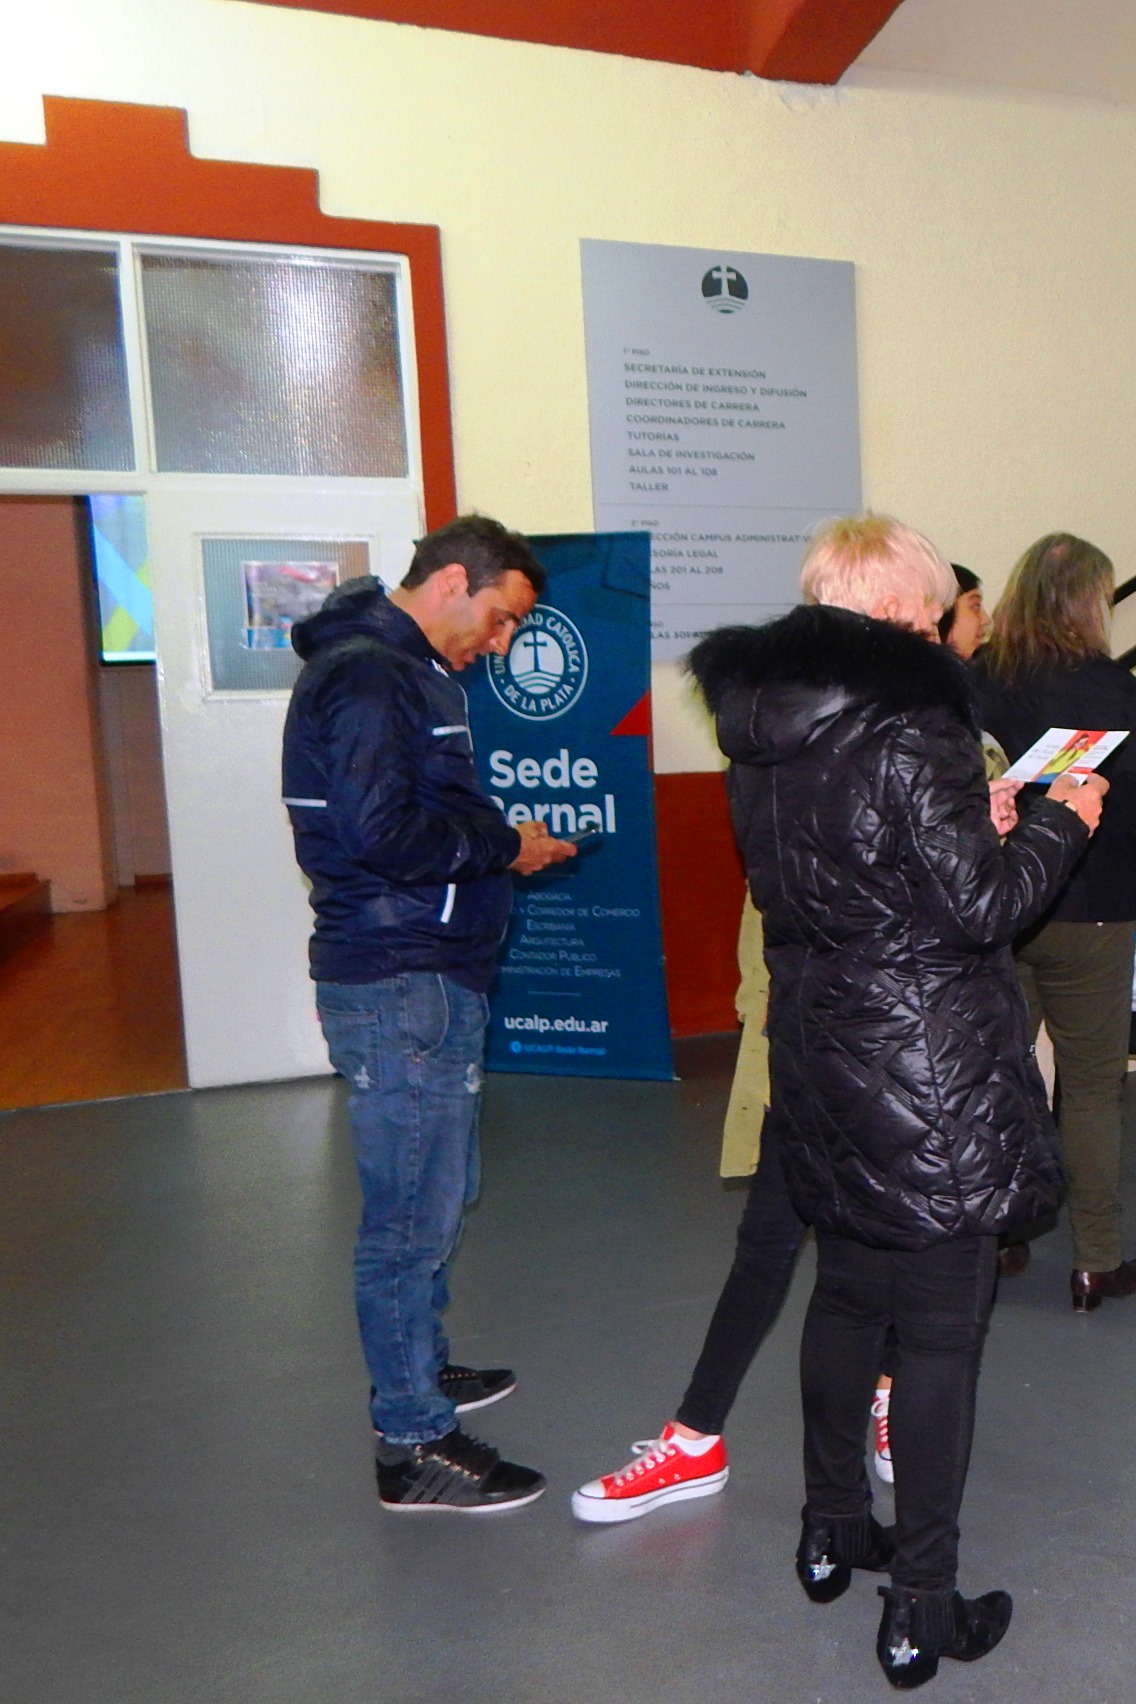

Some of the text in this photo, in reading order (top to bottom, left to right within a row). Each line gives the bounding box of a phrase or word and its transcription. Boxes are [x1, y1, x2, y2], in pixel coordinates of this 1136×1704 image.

[624, 362, 767, 379] SECRETARÍA DE EXTENSIÓN
[625, 380, 807, 398] DIRECCIÓN DE INGRESO Y DIFUSIÓN
[625, 397, 759, 412] DIRECTORES DE CARRERA
[626, 414, 786, 429] COORDINADORES DE CARRERA
[627, 430, 680, 441] TUTORÍAS
[628, 448, 755, 461] SALA DE INVESTIGACIÓN
[629, 465, 664, 475] AULAS
[684, 466, 697, 476] AL
[630, 481, 669, 491] TALLER
[691, 534, 732, 542] CAMPUS
[686, 549, 719, 558] LEGAL
[689, 566, 702, 574] AL
[504, 684, 521, 703] DE
[521, 696, 537, 712] LA
[540, 683, 574, 712] PLATA
[489, 748, 599, 788] Sede
[504, 1014, 609, 1033] ucalp.edu.ar
